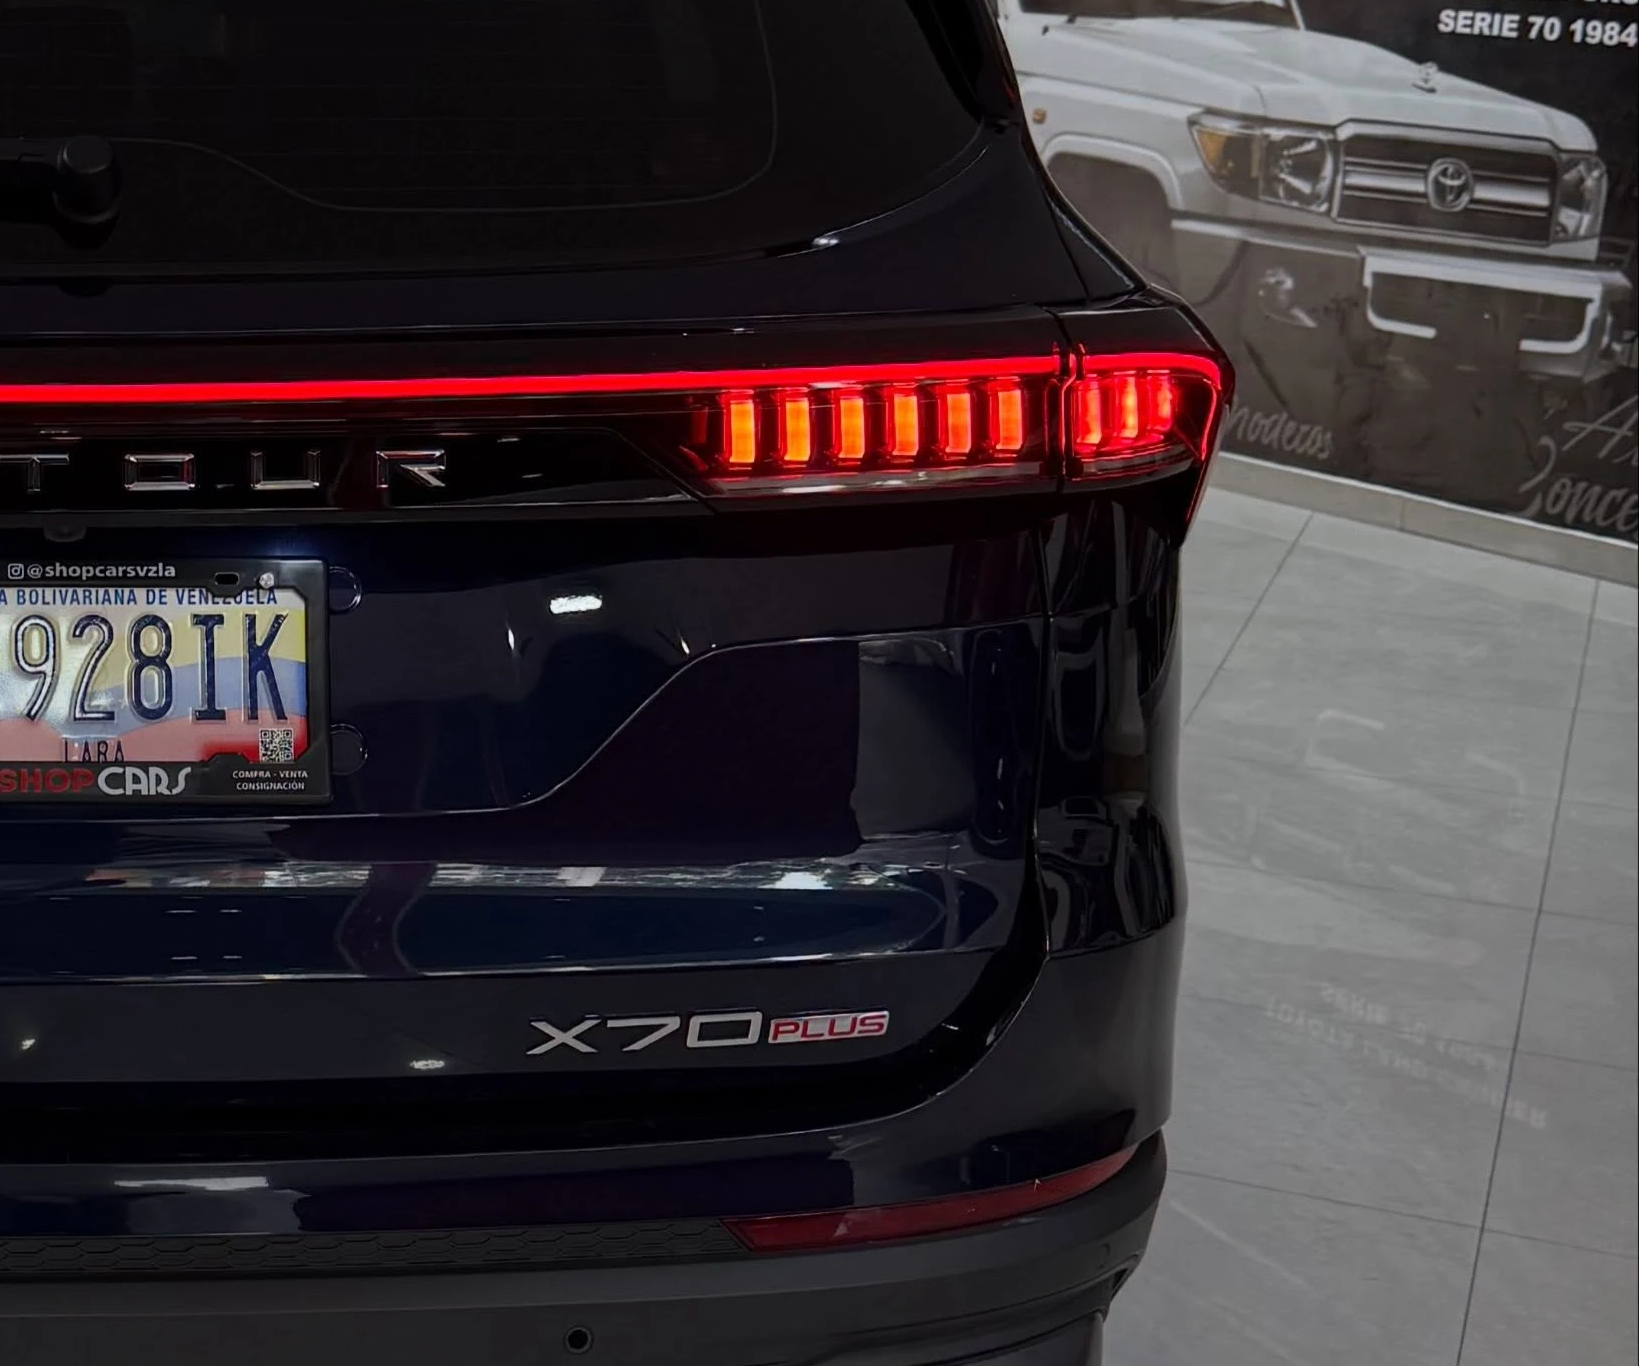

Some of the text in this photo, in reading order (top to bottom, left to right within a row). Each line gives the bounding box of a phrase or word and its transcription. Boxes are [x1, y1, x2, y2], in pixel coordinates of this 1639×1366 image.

[1437, 9, 1638, 48] SERIE 70 1984
[27, 563, 176, 580] @shopcarsvzla
[16, 588, 138, 606] BOLIVARIANA
[146, 588, 168, 605] DE
[232, 770, 271, 779] COMPRA
[279, 770, 309, 778] VENTA
[526, 1010, 887, 1055] X70 PLUS
